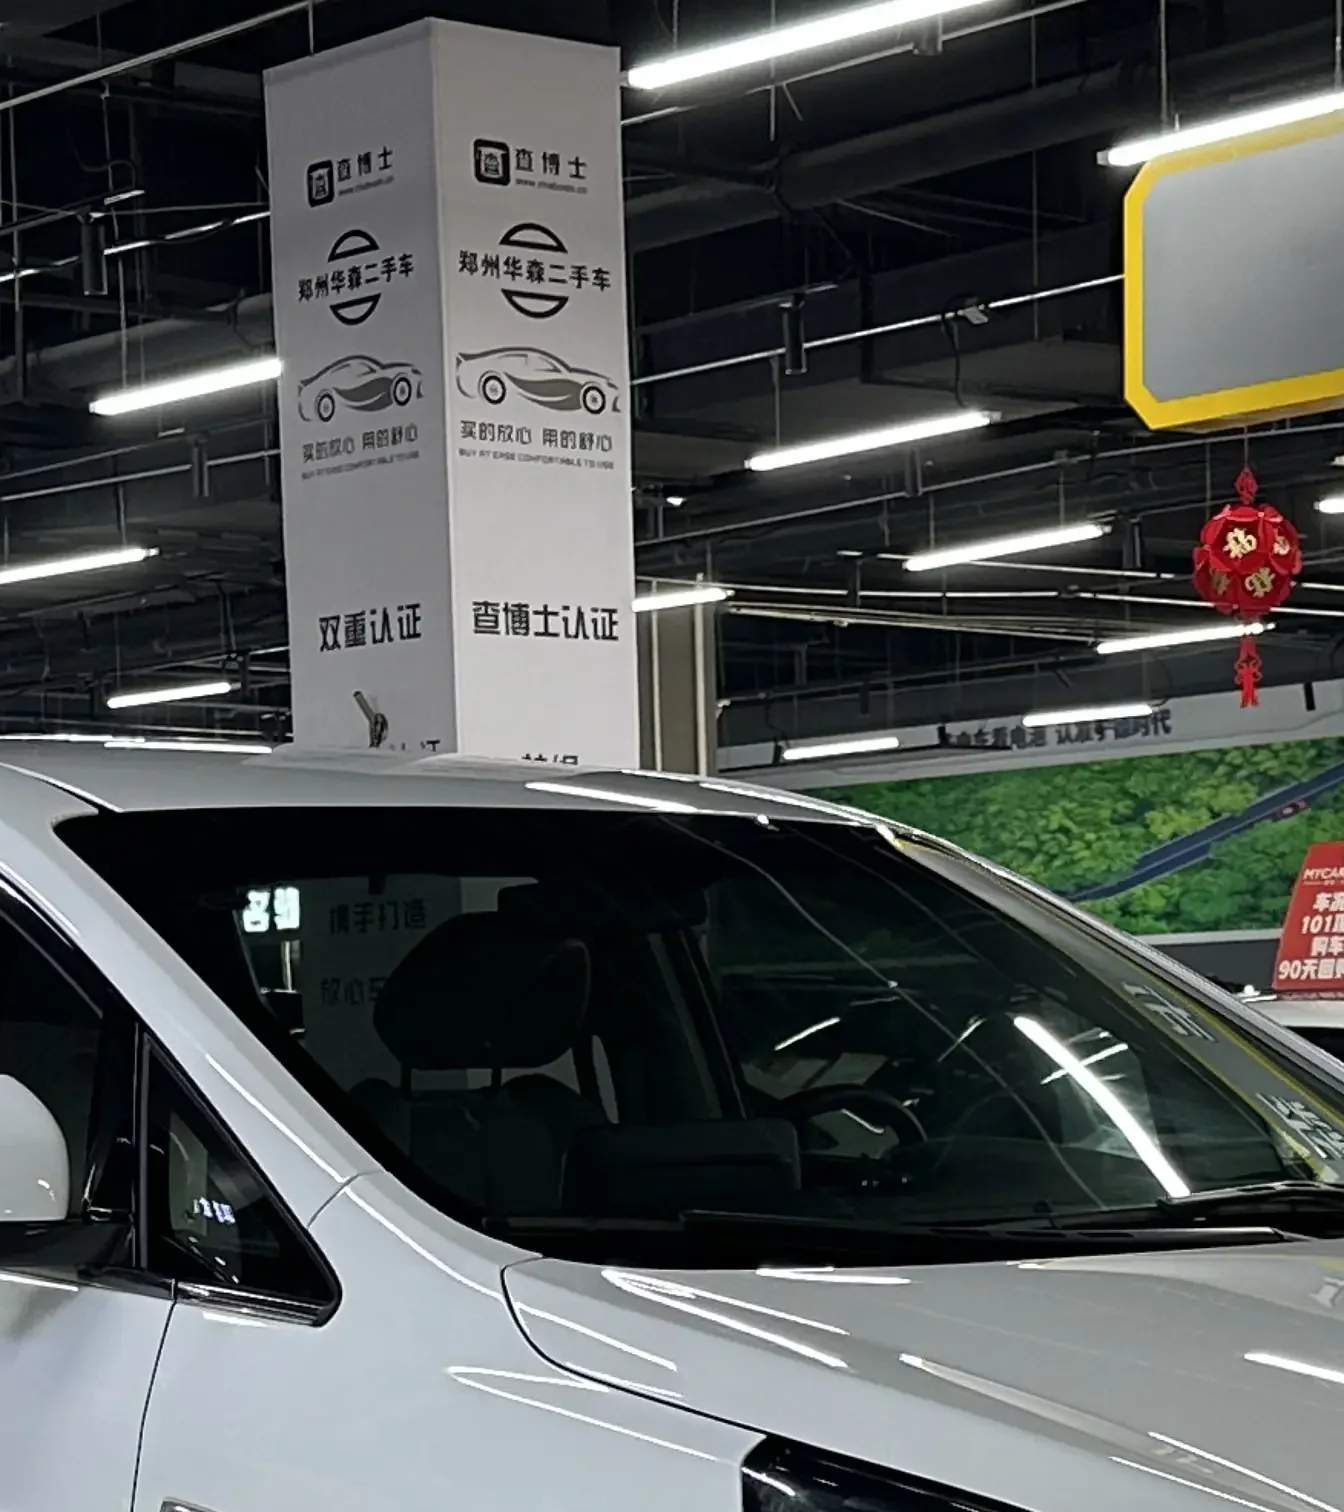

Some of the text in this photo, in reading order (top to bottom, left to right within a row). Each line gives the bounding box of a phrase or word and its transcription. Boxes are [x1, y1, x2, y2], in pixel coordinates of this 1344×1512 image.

[516, 148, 587, 180] 查博士
[298, 253, 414, 302] 郑州华森二手车
[458, 250, 612, 292] 郑州华森二手车
[460, 420, 613, 452] 买的放心 用的舒心
[319, 603, 421, 652] 双重认证
[472, 600, 619, 642] 查博士认证
